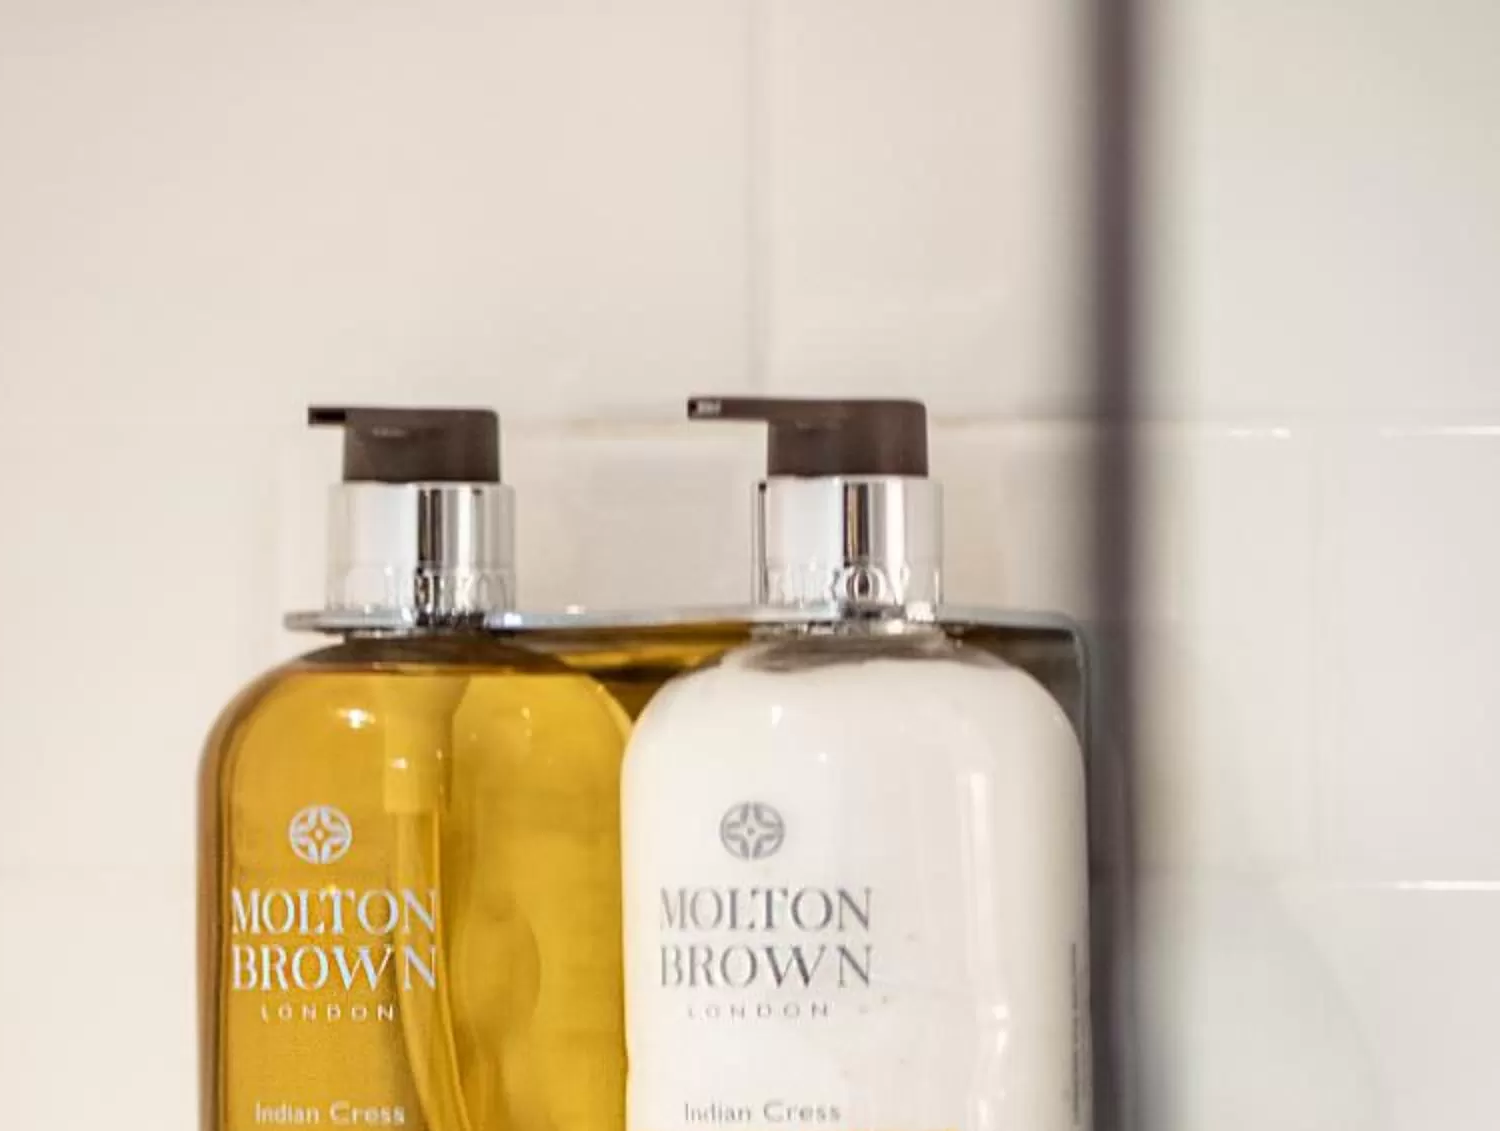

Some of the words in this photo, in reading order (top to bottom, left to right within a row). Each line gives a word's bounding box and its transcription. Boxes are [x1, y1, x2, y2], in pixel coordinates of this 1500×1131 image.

[231, 886, 438, 936] MOLTON
[658, 884, 873, 934] MOLTON
[231, 943, 438, 992] BROWN
[659, 942, 873, 990] BROWN
[261, 1003, 396, 1022] LONDON
[687, 1001, 829, 1020] LONDON
[255, 1101, 320, 1125] Indian
[330, 1100, 405, 1126] Cress
[684, 1101, 751, 1124] Indian
[763, 1099, 841, 1124] Cress
